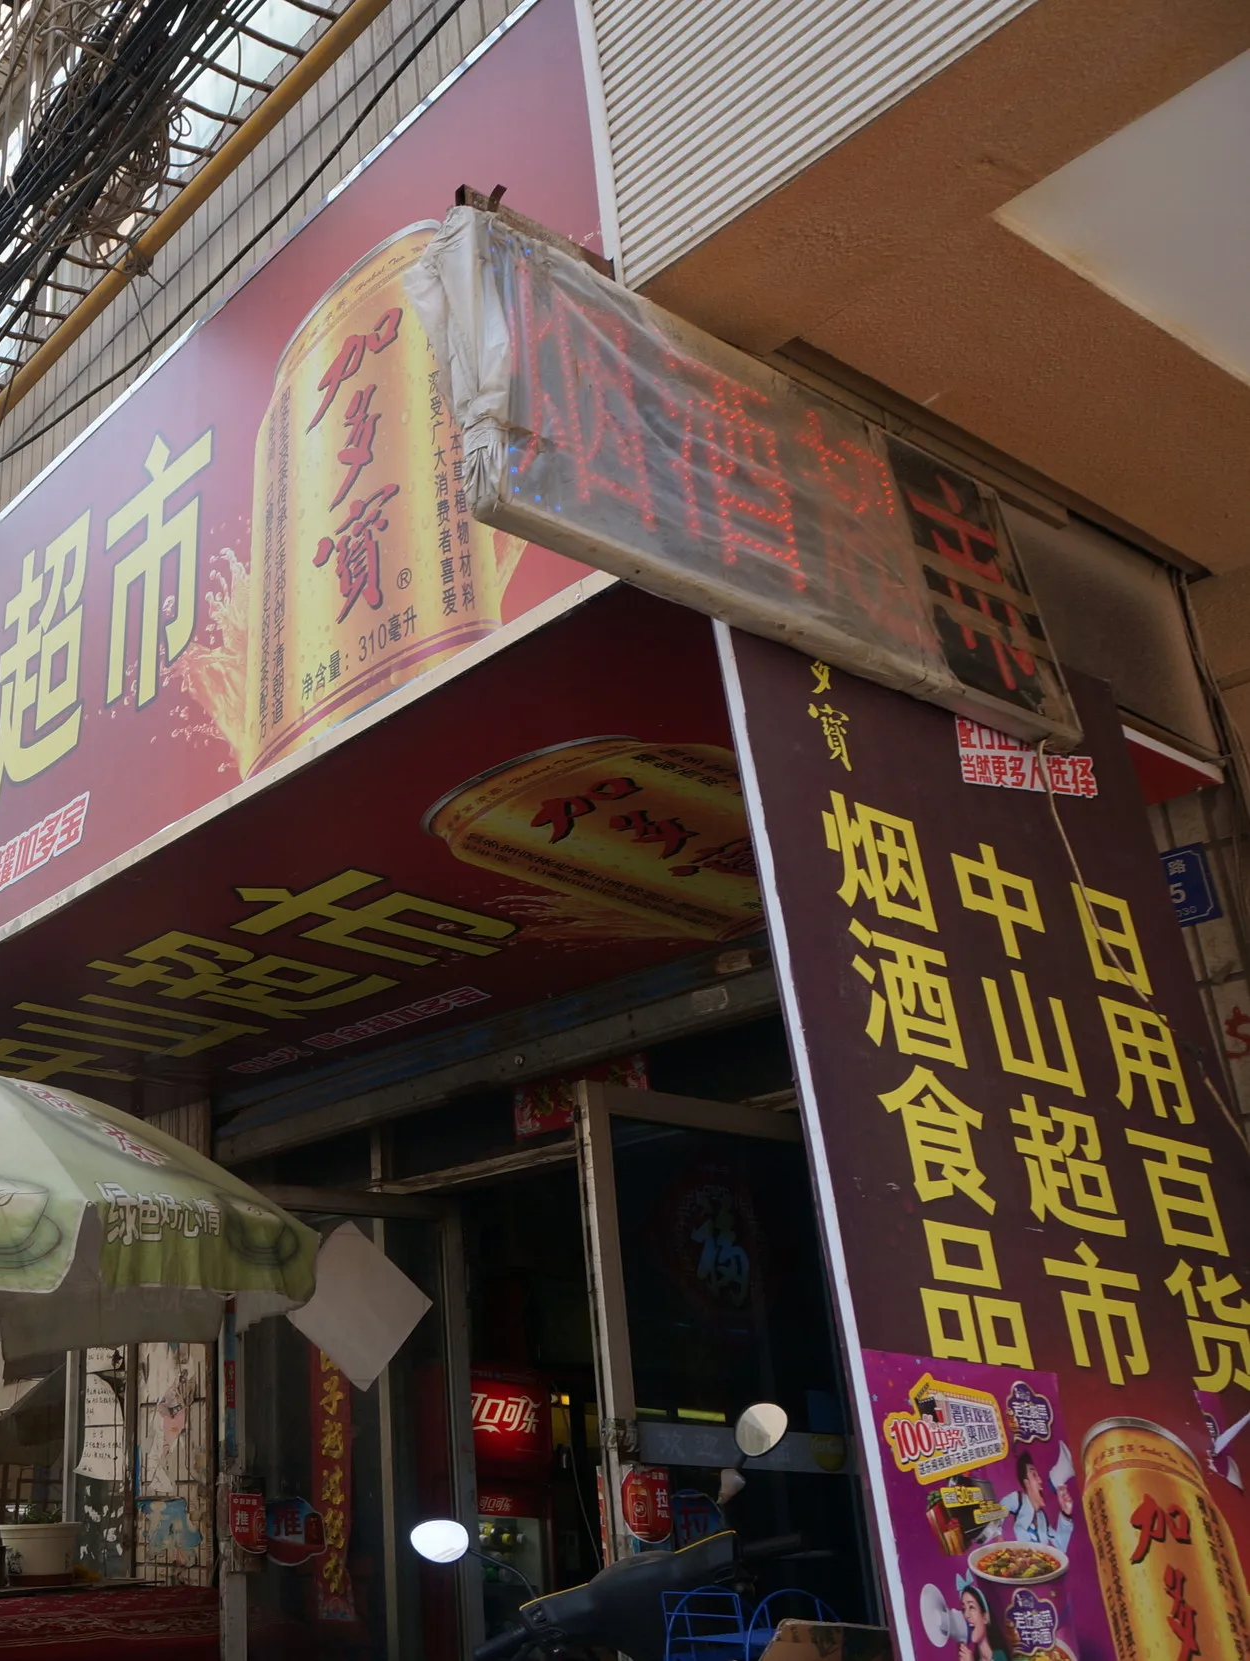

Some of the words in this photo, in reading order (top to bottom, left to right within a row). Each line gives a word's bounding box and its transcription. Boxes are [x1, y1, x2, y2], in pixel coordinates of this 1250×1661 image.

[961, 753, 1098, 798] 当然更多人选择
[821, 790, 1035, 1370] 烟酒食品
[950, 842, 1151, 1386] 中山超市
[1070, 881, 1250, 1393] 日用百货
[96, 1181, 223, 1247] 绿色好心情
[933, 1427, 965, 1454] 中奖
[272, 1503, 303, 1537] 推
